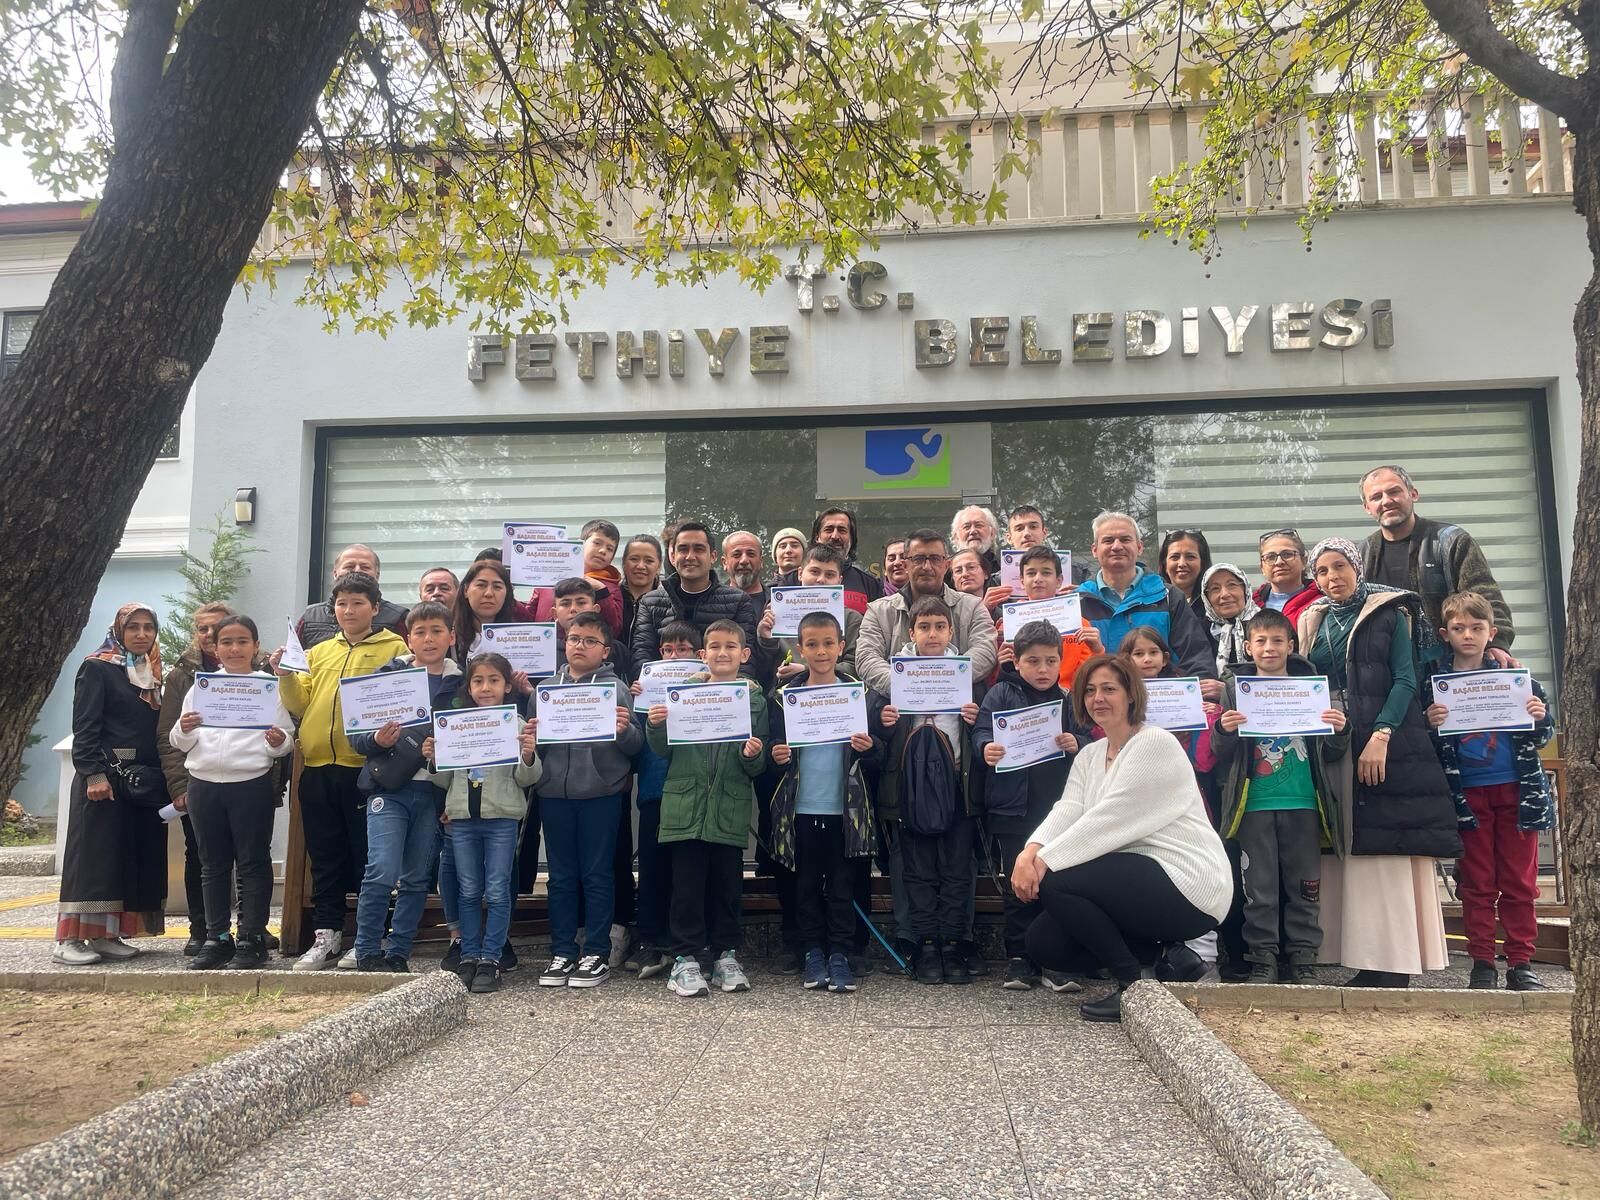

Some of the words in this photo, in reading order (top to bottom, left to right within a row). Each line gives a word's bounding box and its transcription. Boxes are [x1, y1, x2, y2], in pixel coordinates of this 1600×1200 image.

[784, 260, 914, 313] T.C.
[467, 325, 789, 383] FETHİYE
[914, 298, 1395, 369] BELEDİYESİ
[1453, 686, 1480, 694] BAŞARI
